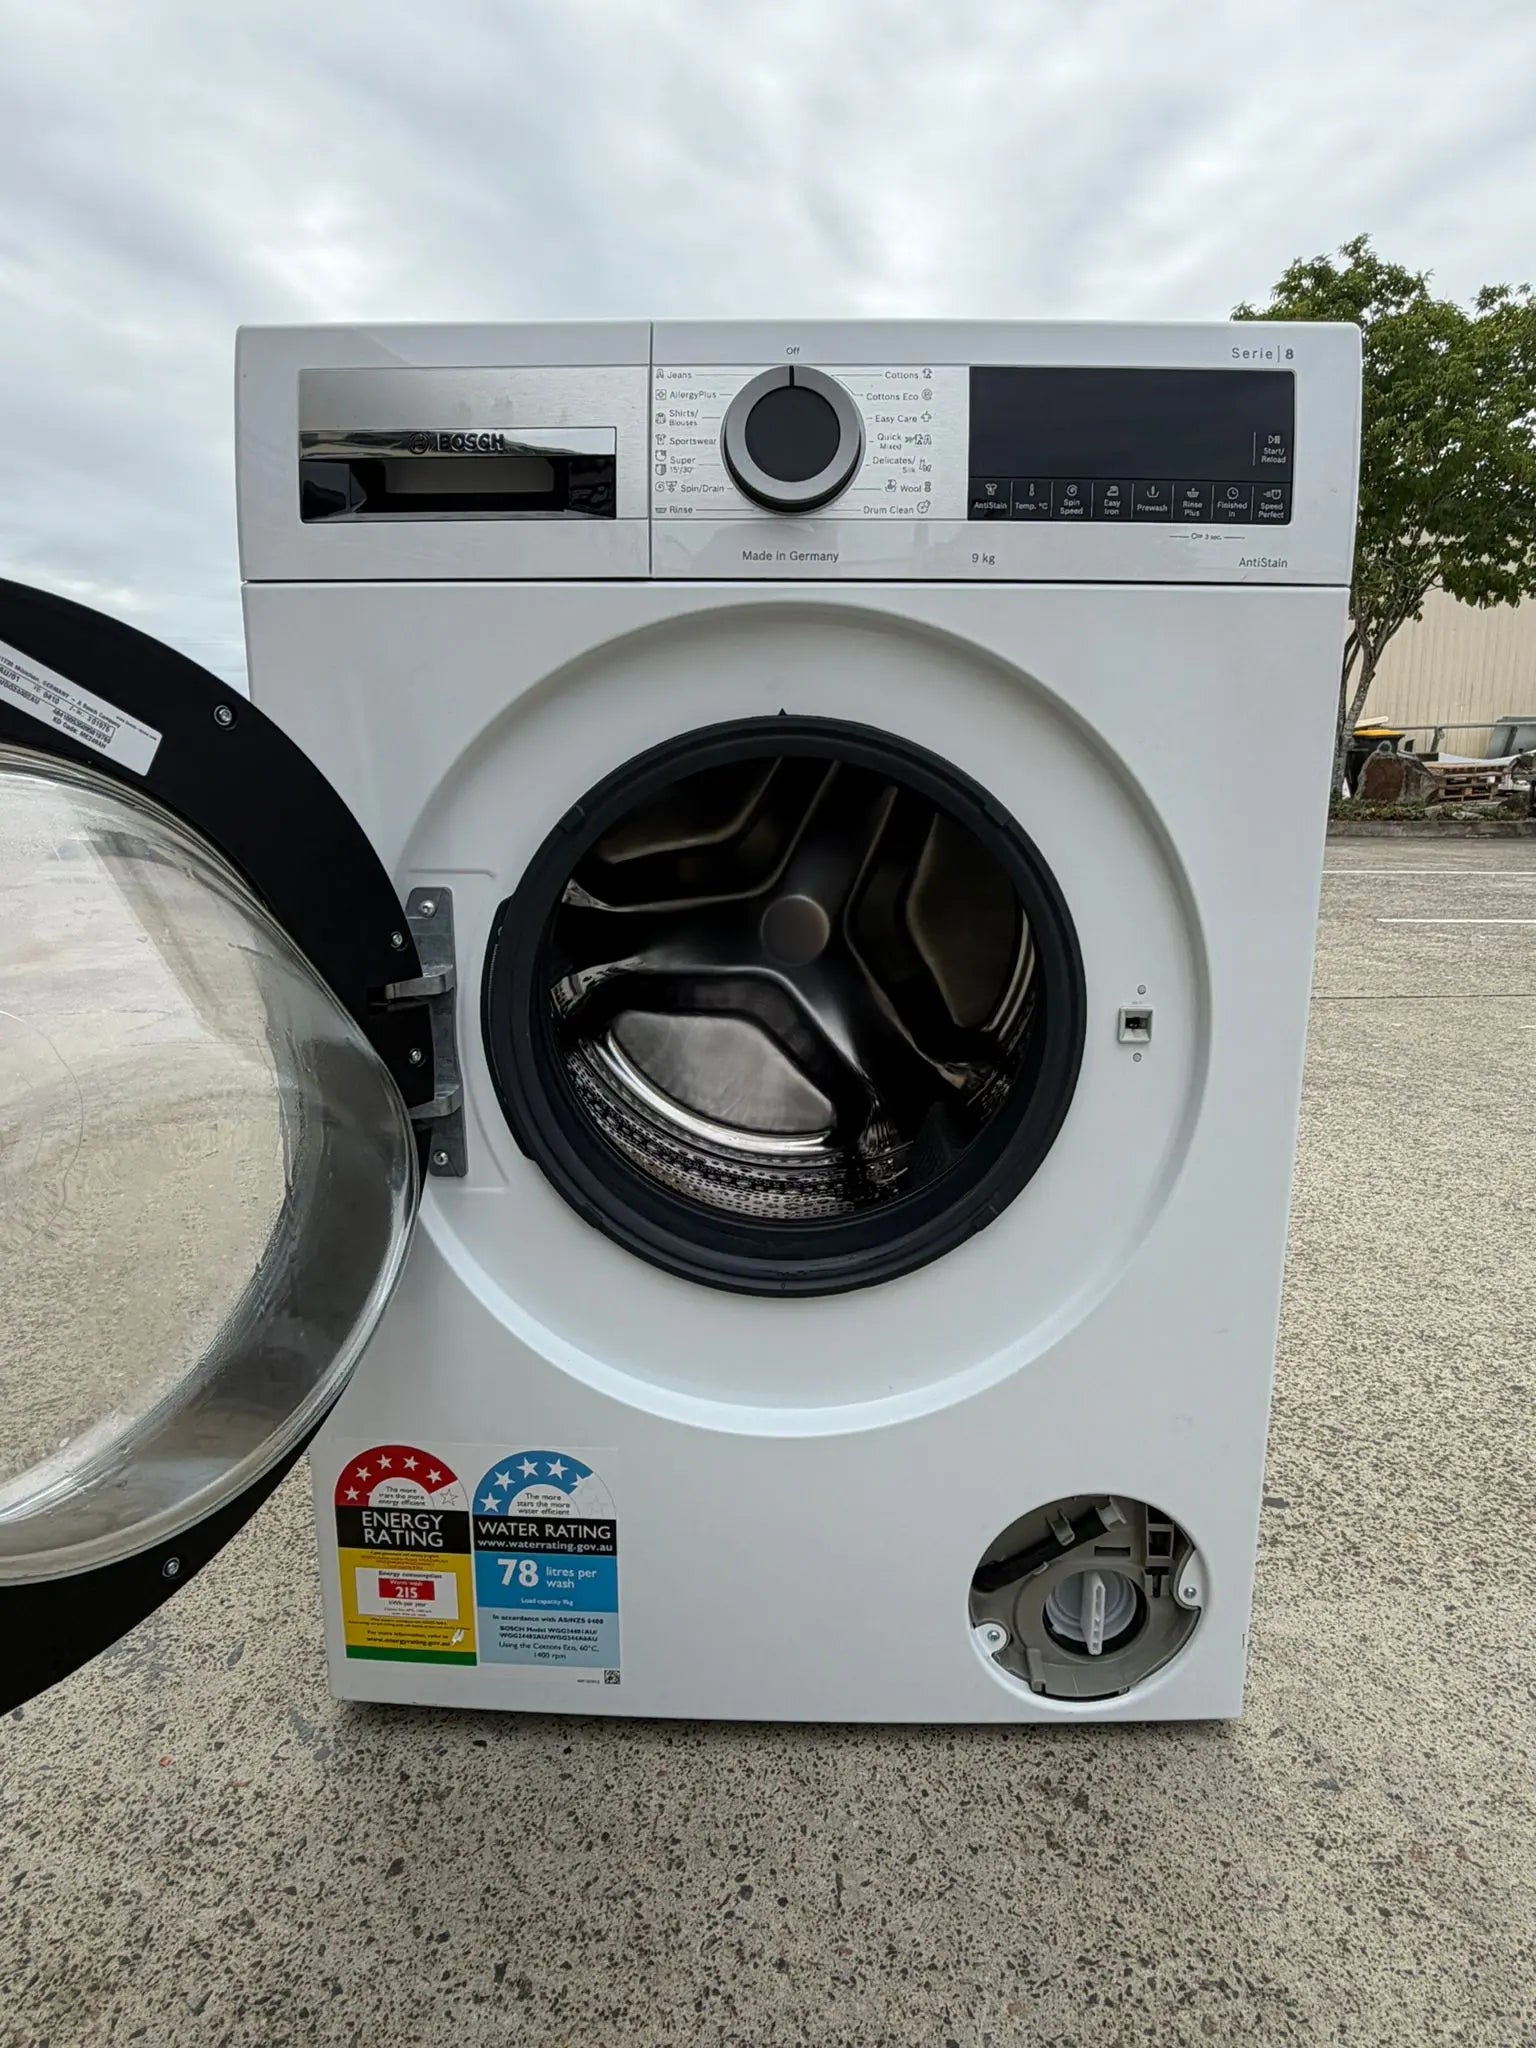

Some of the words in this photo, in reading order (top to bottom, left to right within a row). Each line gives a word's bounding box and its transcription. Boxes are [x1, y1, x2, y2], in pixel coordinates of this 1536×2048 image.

[786, 346, 800, 355] Off
[1231, 347, 1273, 360] Serie
[1285, 348, 1294, 360] 8
[884, 371, 919, 379] Cottons
[669, 391, 717, 400] AllergyPlus
[866, 392, 900, 401] Cottons
[903, 393, 919, 401] Eco
[669, 409, 699, 418] Shirts/
[875, 414, 895, 424] Easy
[897, 414, 918, 423] Care
[669, 437, 717, 446] Sportswear
[877, 433, 901, 441] Quick
[437, 432, 505, 452] BOSCH
[1263, 447, 1285, 455] Start/
[670, 456, 696, 465] Super
[872, 456, 916, 465] Delicates/
[1261, 455, 1286, 463] Reload
[680, 484, 725, 493] Spin/Drain
[900, 484, 921, 492] Wool
[1015, 502, 1036, 510] Temp.
[1063, 499, 1080, 507] Spin
[1104, 500, 1121, 508] Easy
[1183, 501, 1203, 509] Rinse
[1217, 501, 1247, 510] Finished
[1260, 502, 1283, 511] Speed
[669, 505, 693, 514] Rinse
[863, 505, 887, 514] Drum
[889, 505, 914, 514] Clean
[1060, 508, 1084, 516] Speed
[1137, 504, 1168, 512] Prewash
[1184, 509, 1200, 517] Plus
[1258, 511, 1284, 519] Perfect
[742, 550, 773, 561] Made
[776, 550, 786, 561] in
[789, 550, 839, 563] Germany
[971, 553, 979, 563] 9
[982, 553, 996, 565] kg
[1238, 558, 1288, 568] AntiStain
[541, 1508, 570, 1516] efficient
[361, 1511, 444, 1530] ENERGY
[478, 1521, 540, 1537] WATER
[545, 1524, 612, 1539] RATING
[364, 1528, 444, 1547] RATING
[478, 1539, 613, 1553] www.waterrating.gov.au
[378, 1570, 400, 1578] Energy
[497, 1558, 540, 1588] 78
[546, 1566, 575, 1577] litres
[578, 1568, 597, 1580] per
[546, 1579, 575, 1589] wash
[395, 1586, 418, 1599] 215
[498, 1641, 518, 1650] Using
